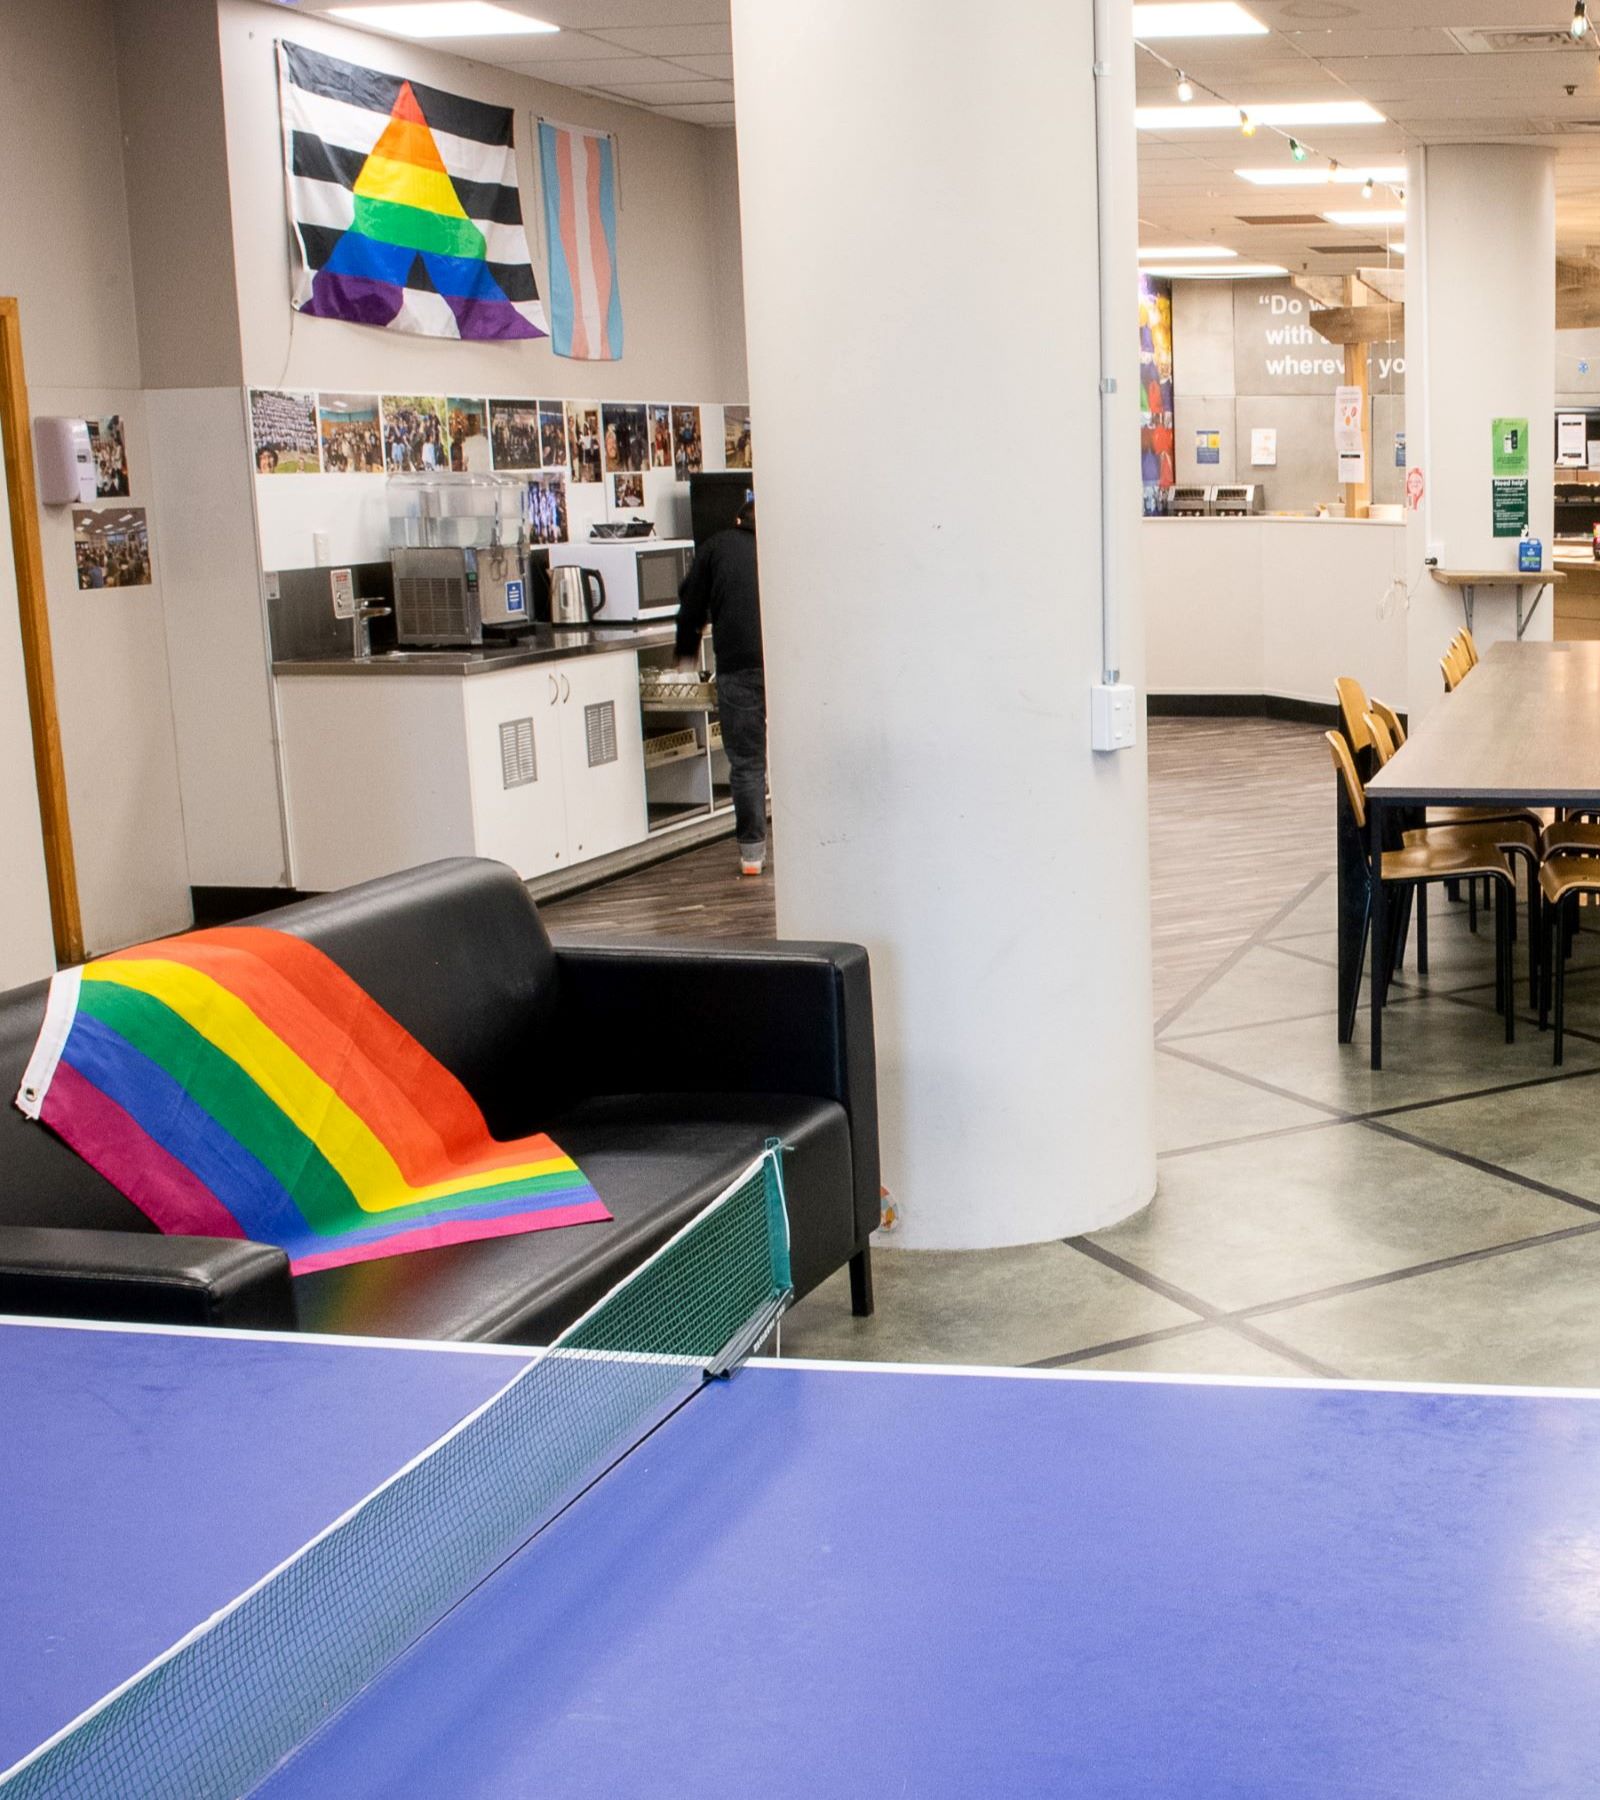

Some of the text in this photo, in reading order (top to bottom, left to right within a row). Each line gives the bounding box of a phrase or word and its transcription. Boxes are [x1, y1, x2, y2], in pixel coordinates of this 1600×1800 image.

[1265, 325, 1313, 345] with
[1265, 355, 1405, 378] wherev yo
[1512, 480, 1527, 488] help?
